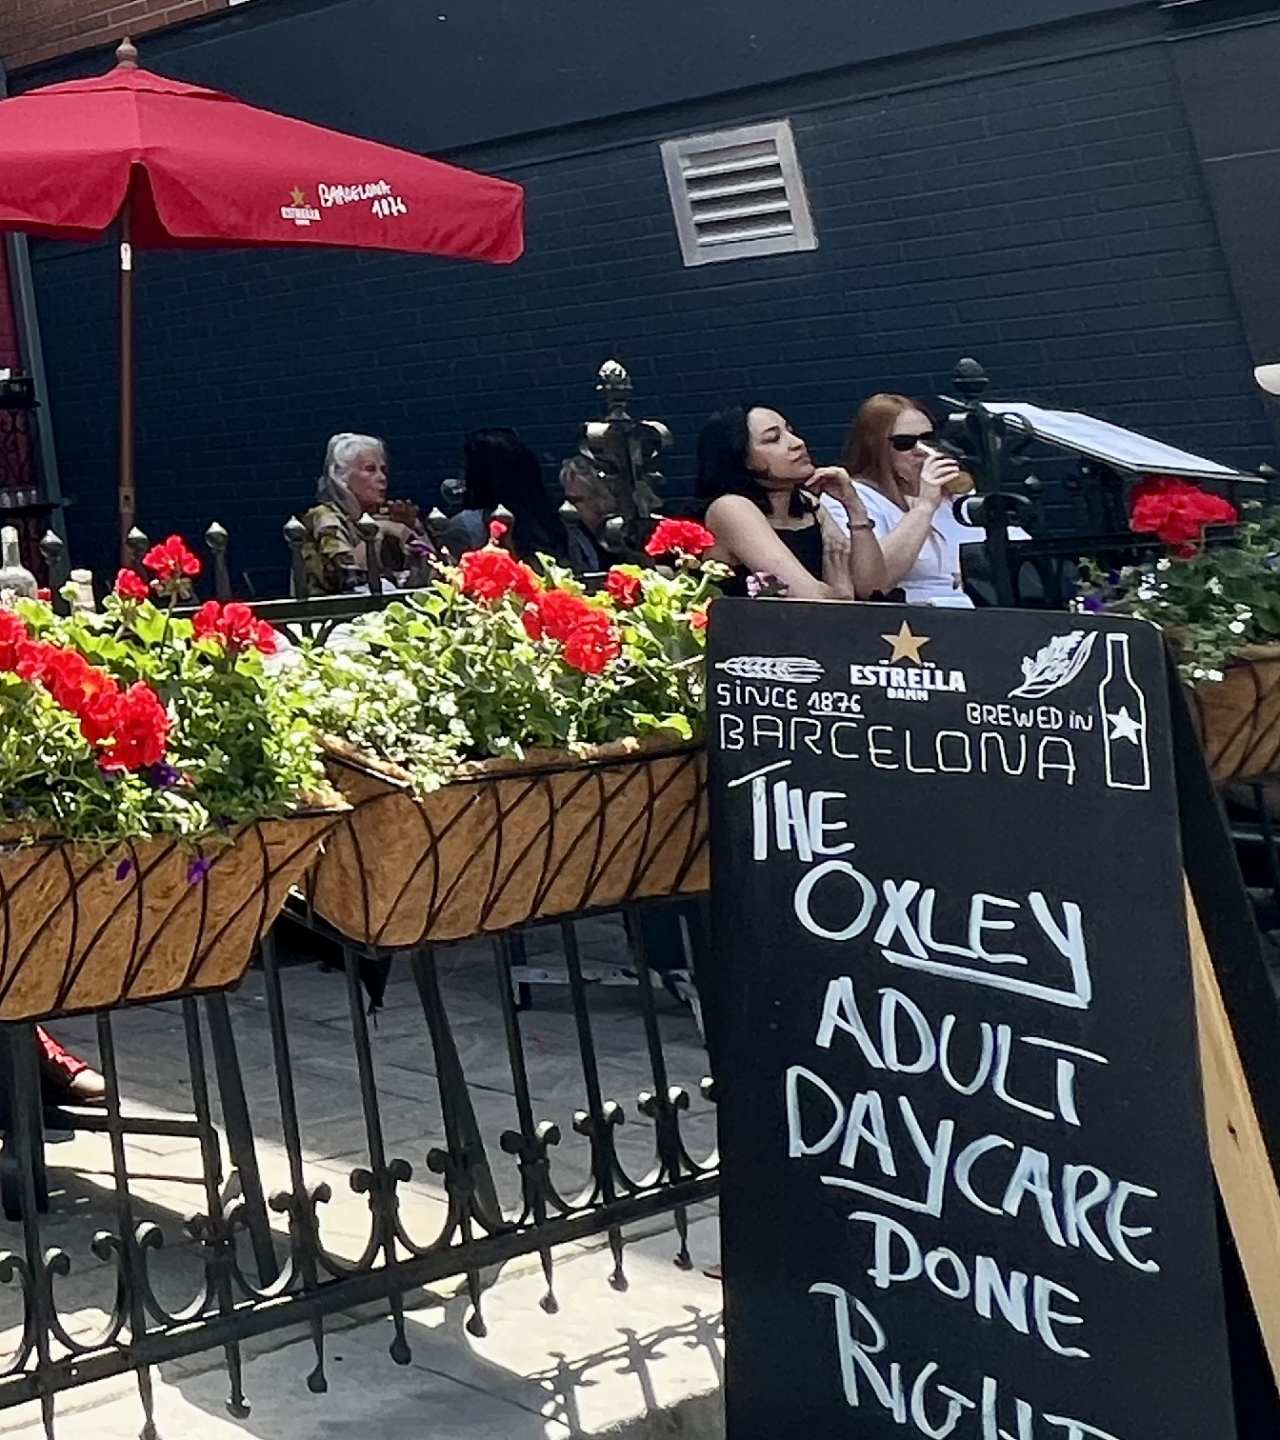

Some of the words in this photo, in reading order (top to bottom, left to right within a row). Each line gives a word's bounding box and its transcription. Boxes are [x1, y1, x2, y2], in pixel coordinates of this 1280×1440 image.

[720, 714, 1076, 785] BARCELONA
[807, 690, 862, 713] 1876
[966, 703, 1063, 730] BREWED
[728, 760, 856, 861] THE
[794, 861, 1092, 1008] OXLEY
[815, 977, 1108, 1126] ADULT
[786, 1065, 1159, 1273] DAYCARE
[848, 1210, 1090, 1358] DONE
